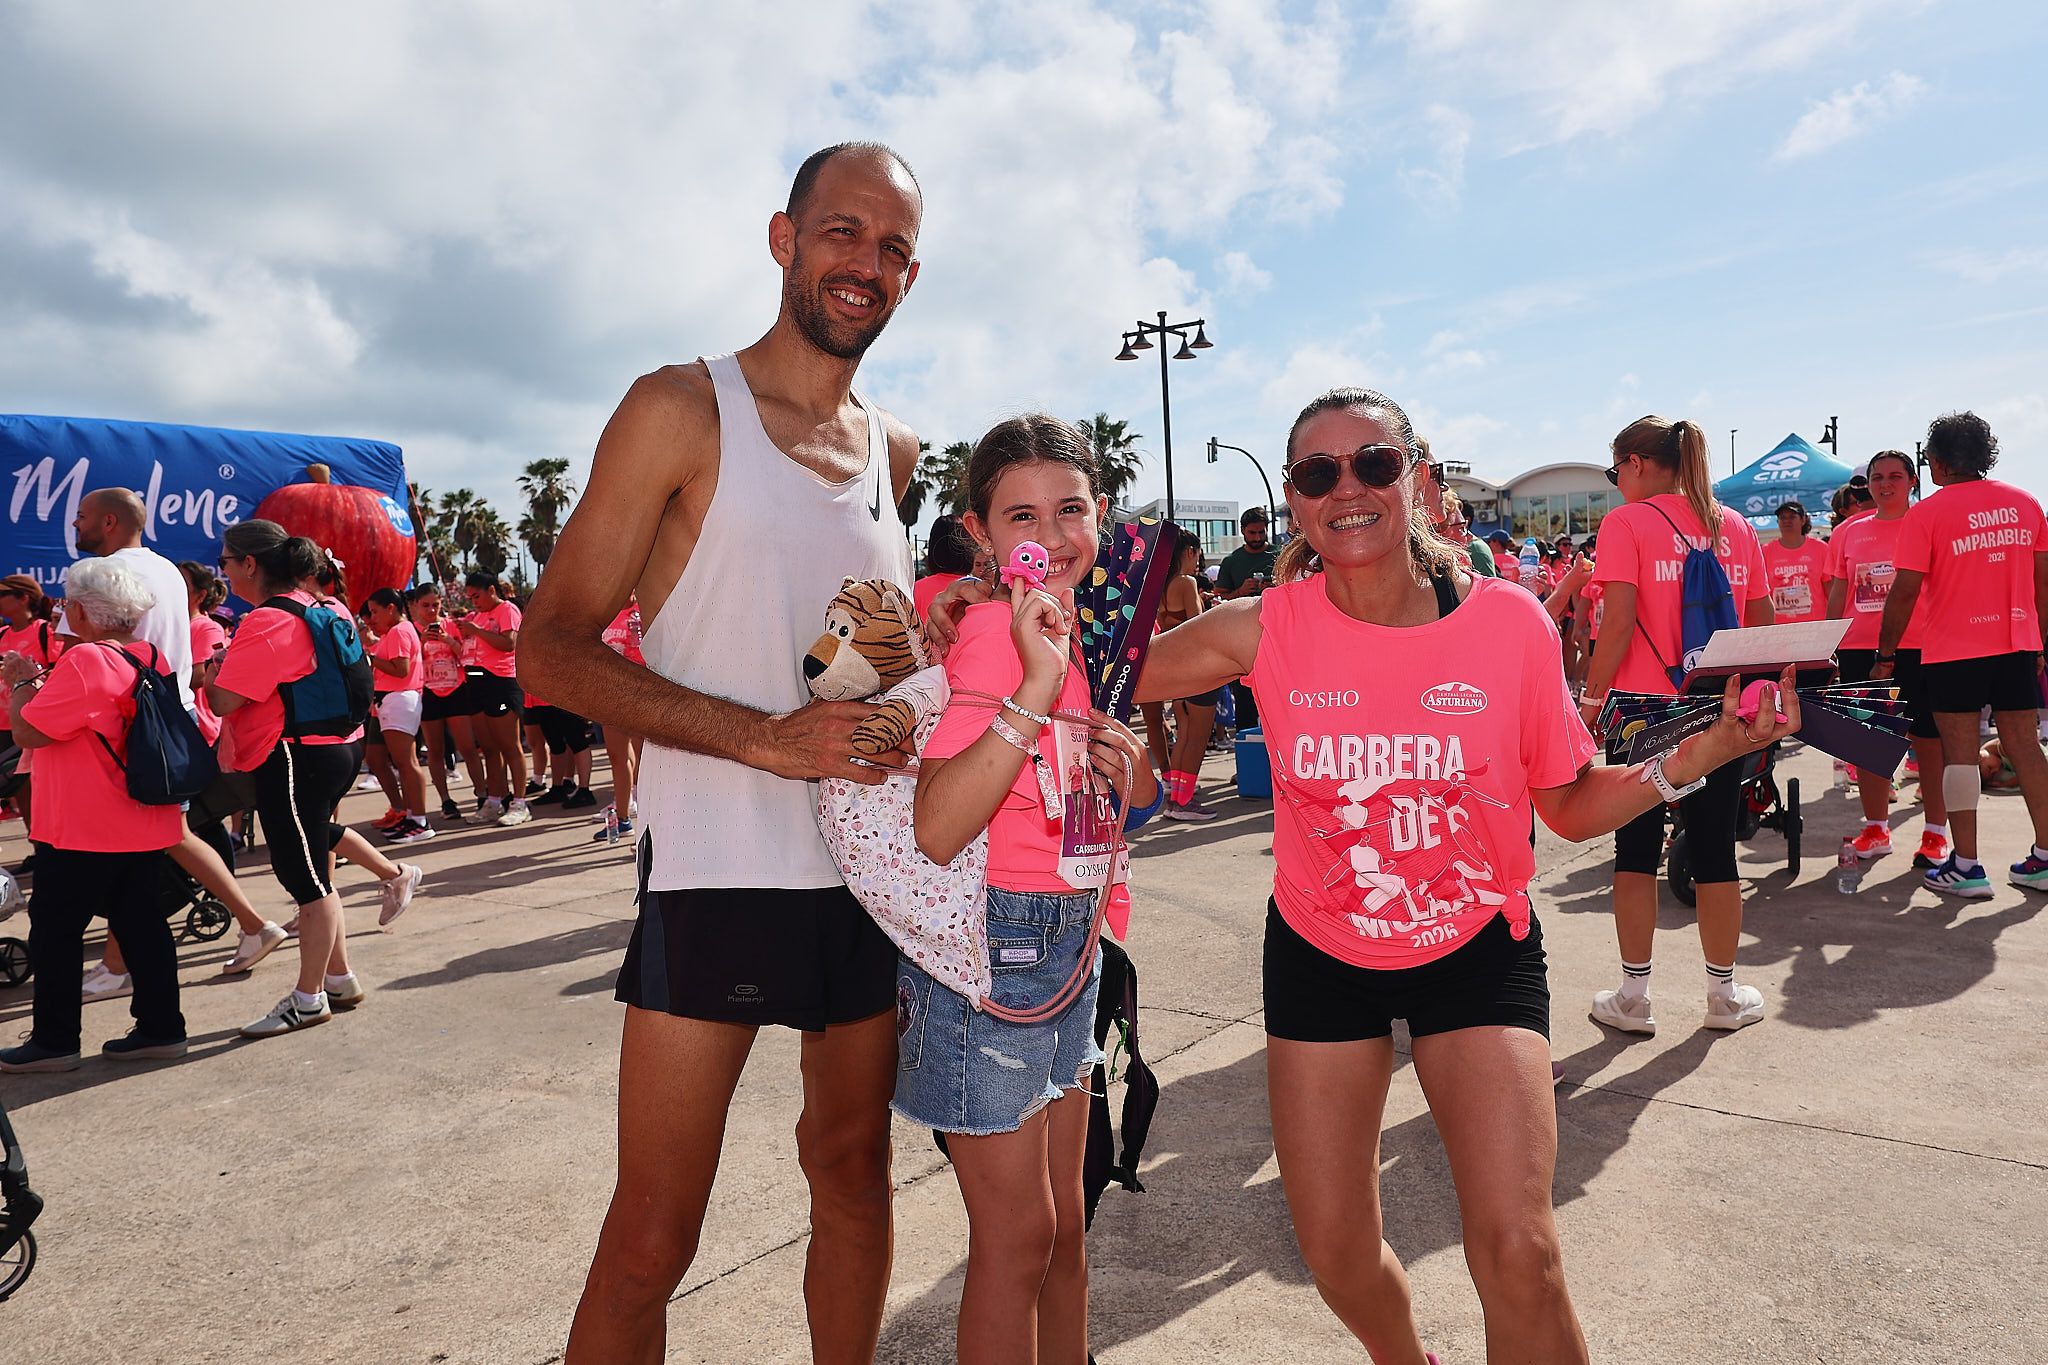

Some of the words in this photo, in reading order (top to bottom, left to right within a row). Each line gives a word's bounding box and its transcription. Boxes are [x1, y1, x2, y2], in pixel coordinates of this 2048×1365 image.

[1753, 469, 1801, 481] CIM
[1968, 507, 2019, 530] SOMOS
[1952, 529, 2032, 556] IMPARABLES
[1969, 615, 2000, 624] OYSHO
[1107, 665, 1131, 718] octopus
[1289, 690, 1360, 708] OYSHO
[1426, 693, 1483, 707] ASTURIANA
[1293, 734, 1466, 781] CARRERA
